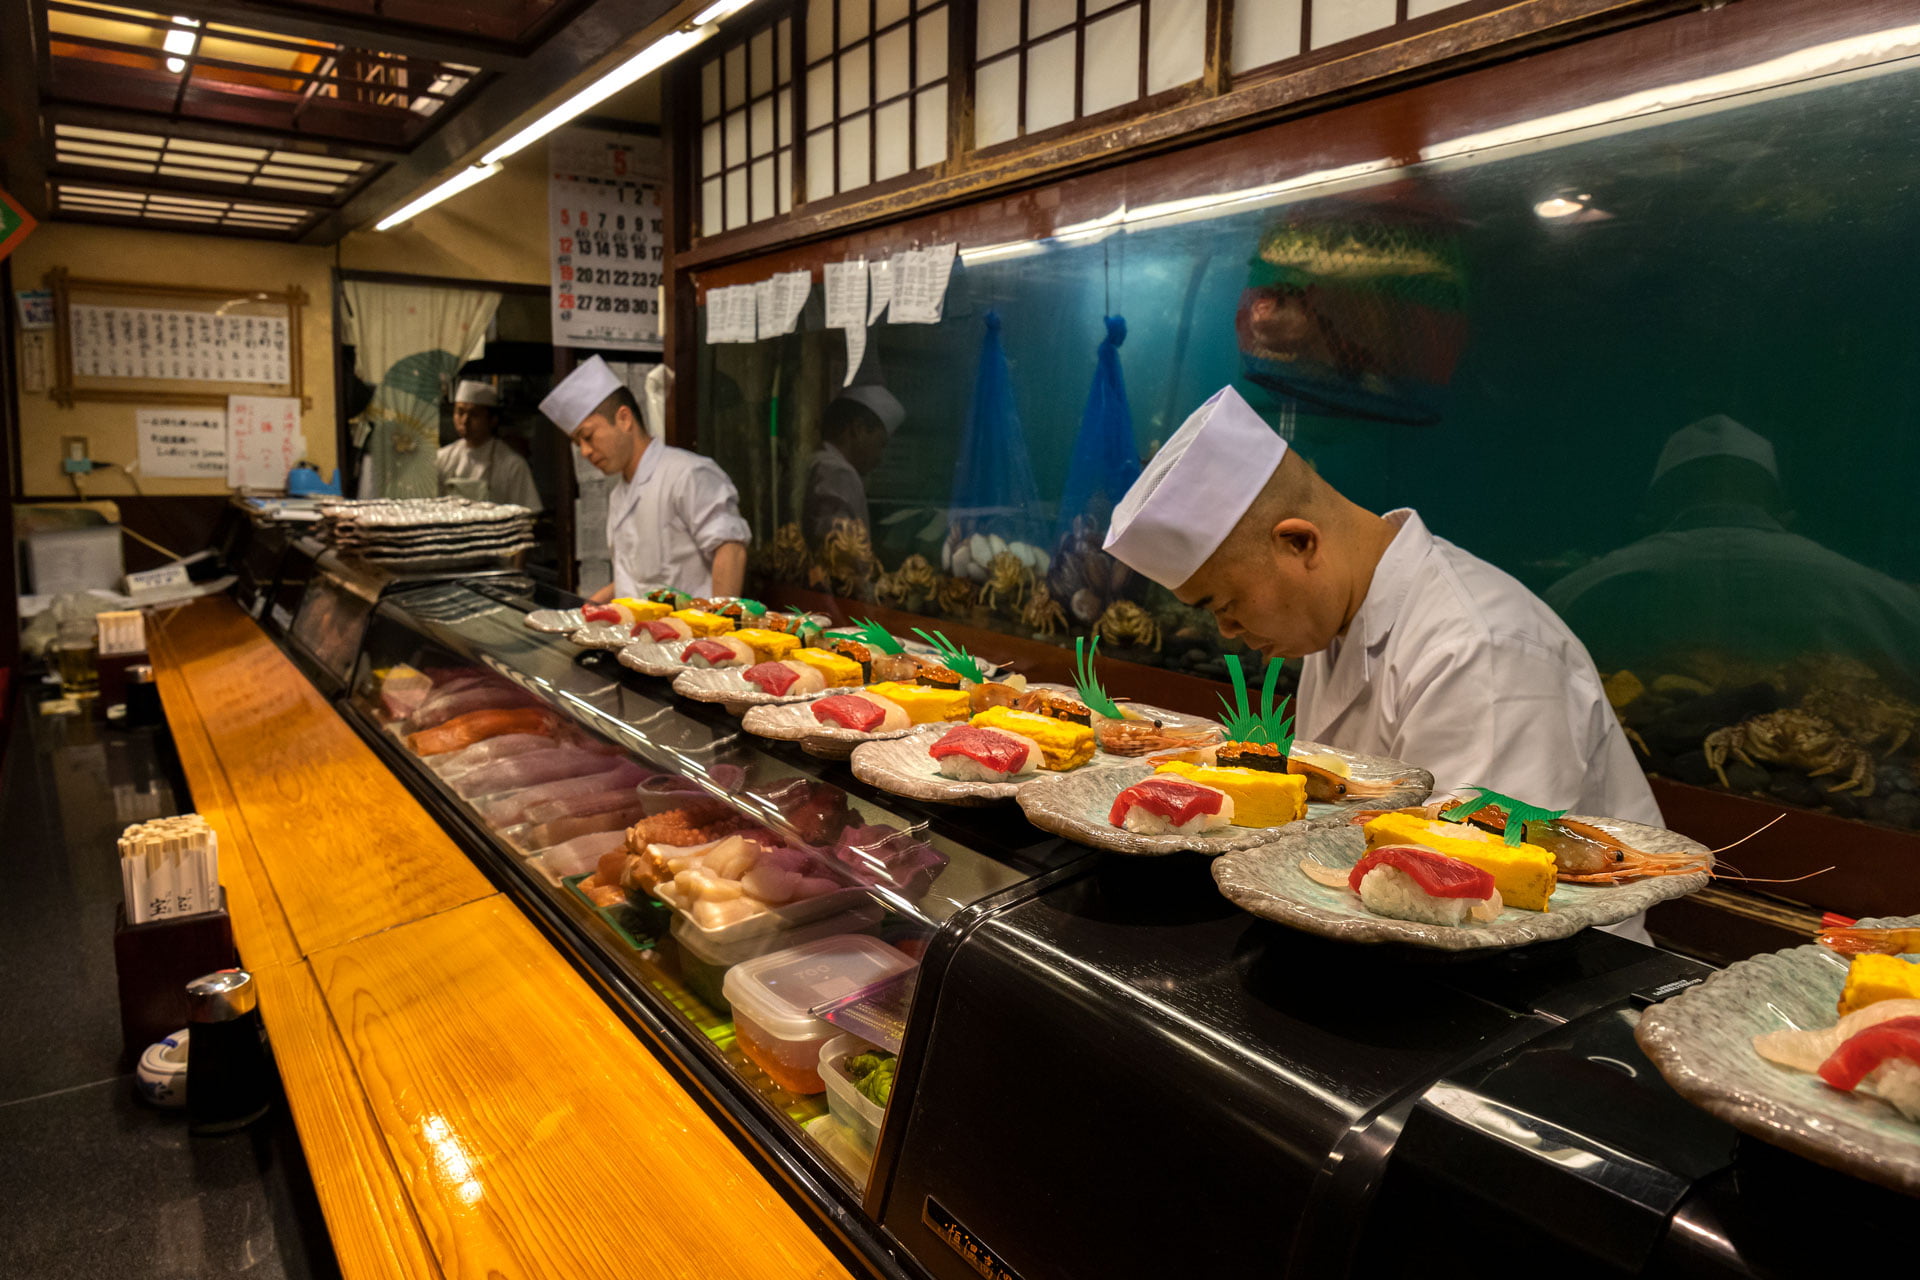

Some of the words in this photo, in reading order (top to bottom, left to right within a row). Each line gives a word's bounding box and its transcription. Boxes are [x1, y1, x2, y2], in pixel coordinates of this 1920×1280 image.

[614, 150, 627, 176] 5
[618, 188, 625, 203] 1
[634, 189, 643, 205] 2
[561, 208, 570, 225] 5
[580, 210, 589, 227] 6
[598, 213, 607, 228] 7
[616, 215, 625, 231] 8
[634, 217, 644, 232] 9
[559, 237, 573, 254] 12
[578, 239, 592, 255] 13
[596, 241, 610, 257] 14
[614, 243, 629, 258] 15
[633, 244, 647, 260] 16
[576, 267, 593, 283] 20
[596, 268, 611, 285] 21
[613, 270, 630, 286] 22
[632, 272, 648, 287] 23
[577, 295, 593, 311] 27
[596, 297, 612, 312] 28
[614, 298, 630, 313] 29
[632, 299, 648, 315] 30
